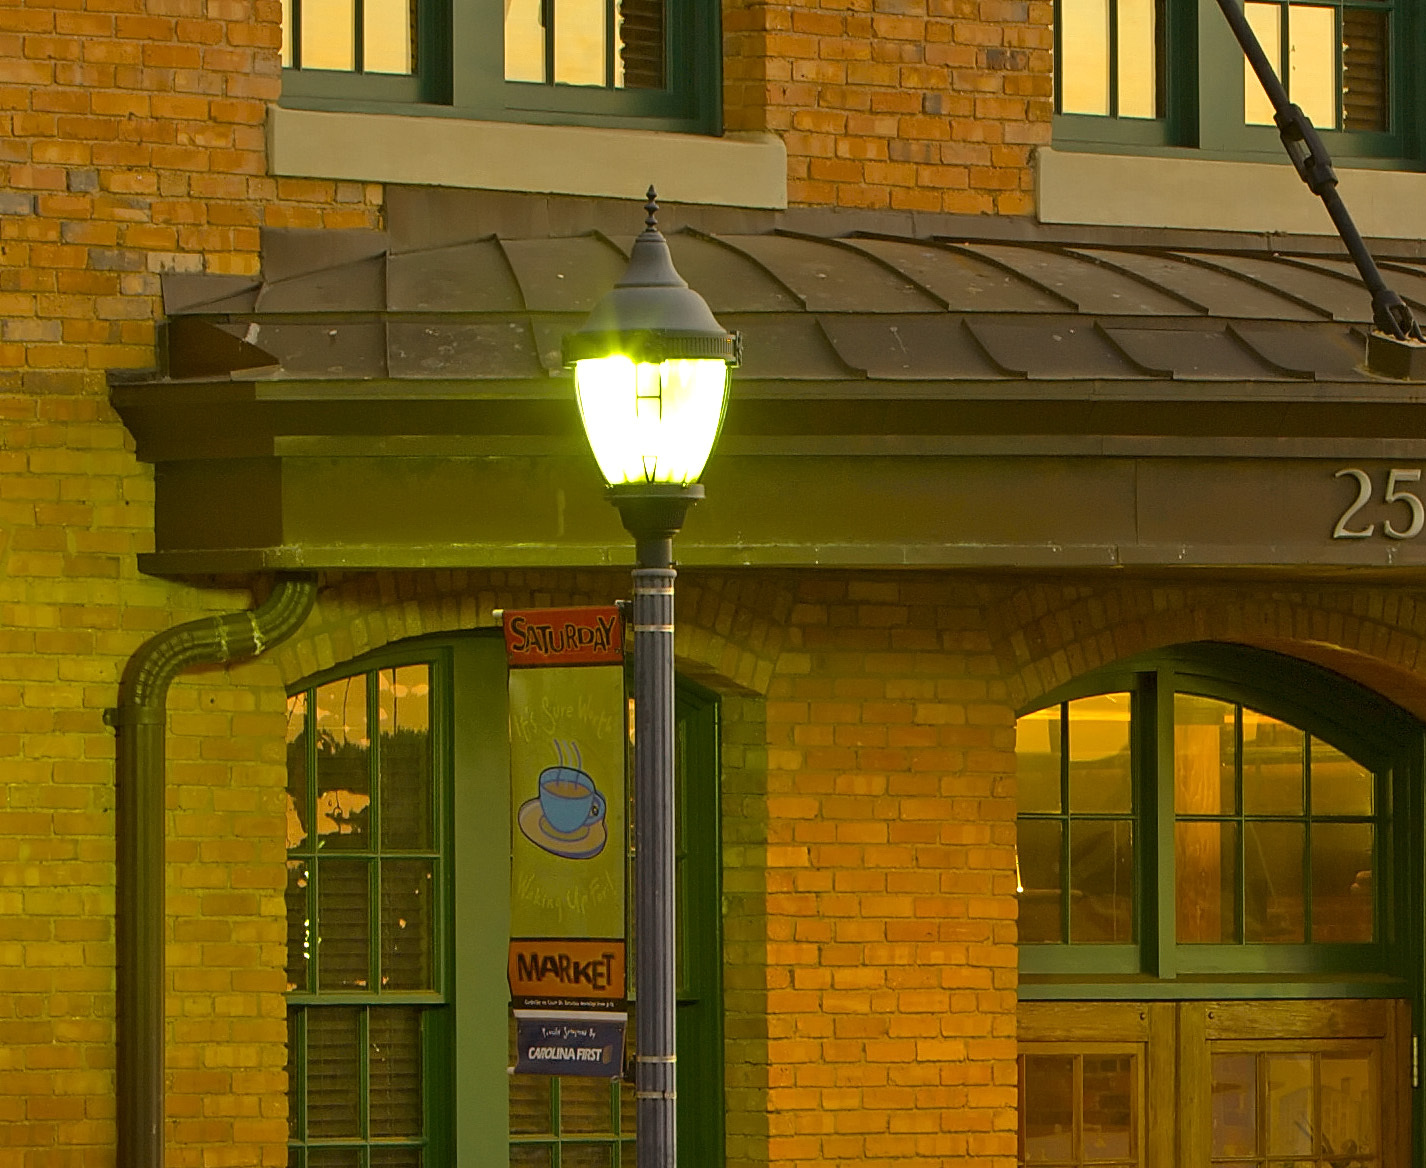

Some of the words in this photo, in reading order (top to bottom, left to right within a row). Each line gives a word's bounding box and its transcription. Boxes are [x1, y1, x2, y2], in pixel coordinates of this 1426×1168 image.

[1333, 468, 1426, 541] 25
[510, 615, 616, 656] SATURDAY
[541, 696, 574, 736] Sure
[517, 952, 615, 991] MARKET
[528, 1046, 576, 1061] CAROLINA
[576, 1048, 603, 1062] FIRST
